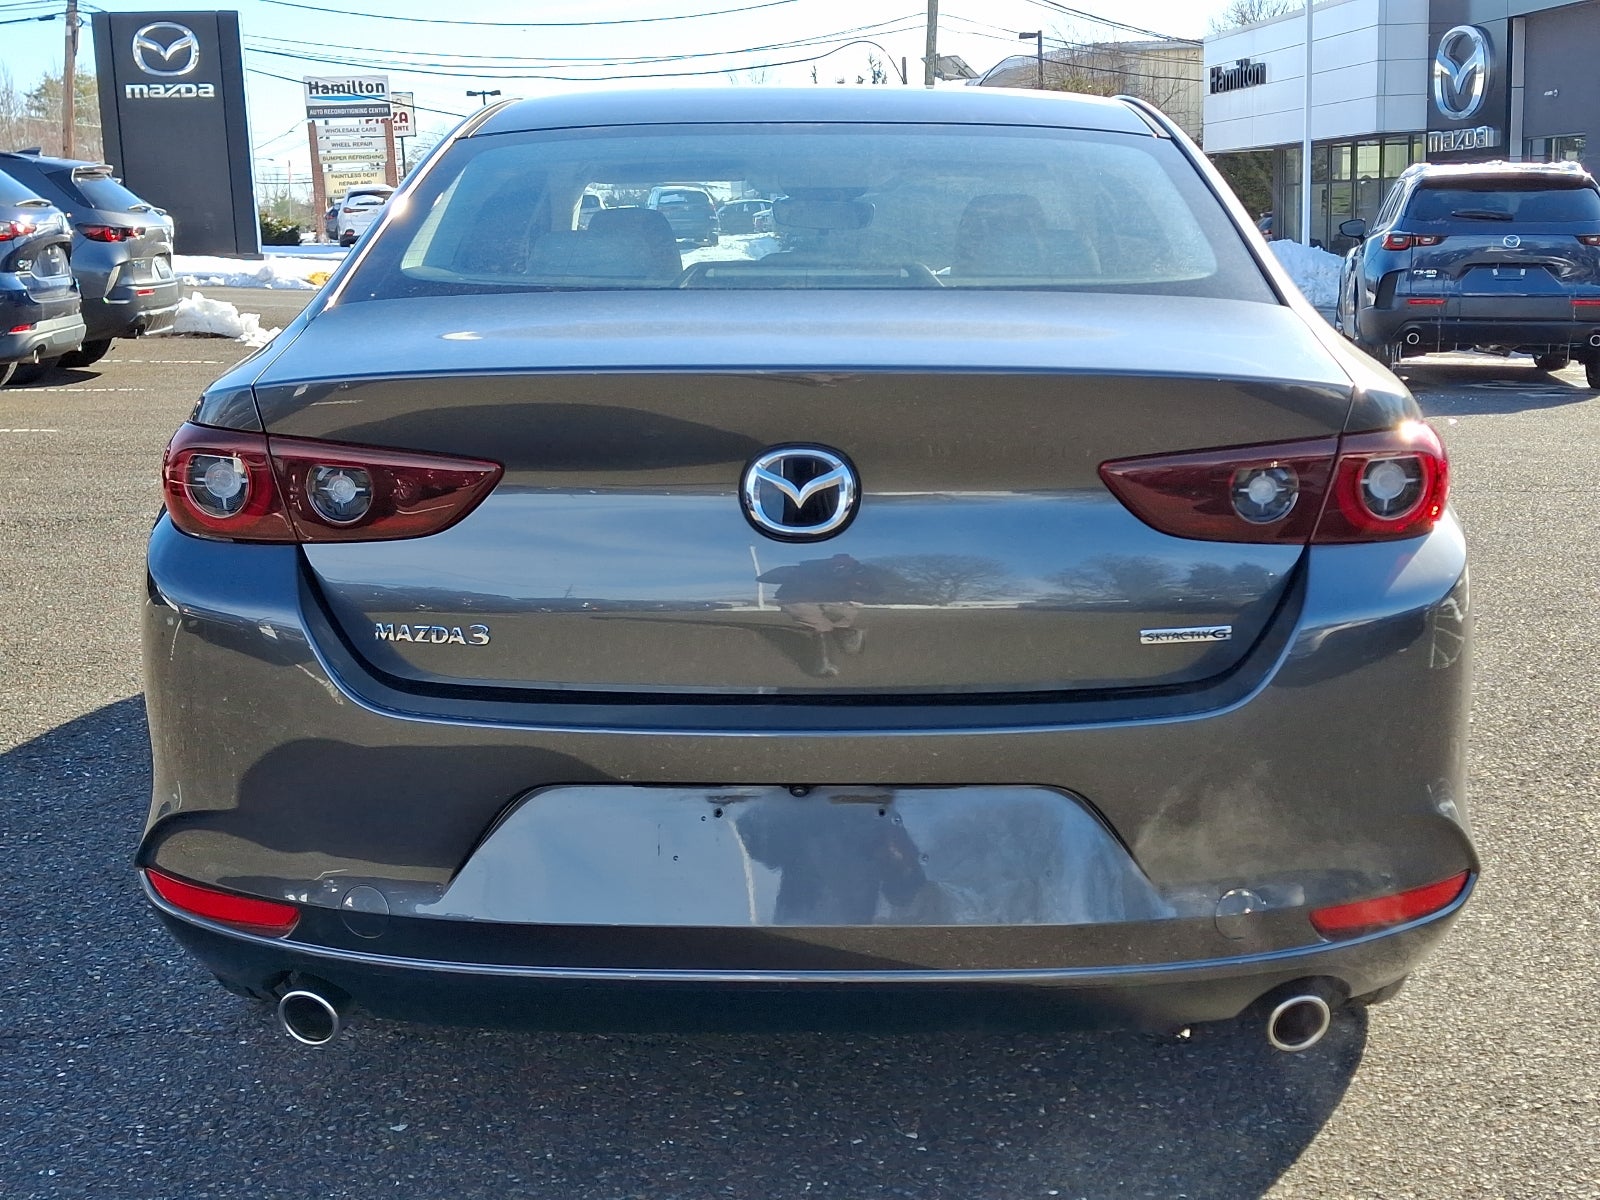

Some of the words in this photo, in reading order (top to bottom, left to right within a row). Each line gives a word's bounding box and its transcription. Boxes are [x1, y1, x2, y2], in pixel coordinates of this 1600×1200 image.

[1209, 58, 1267, 95] Hamilton
[125, 83, 215, 99] mazda
[308, 80, 385, 94] Hamilton
[309, 108, 323, 116] AUTO
[323, 107, 368, 115] RECONDITIONING
[1427, 125, 1495, 153] mazda
[374, 622, 491, 646] MAZDA3
